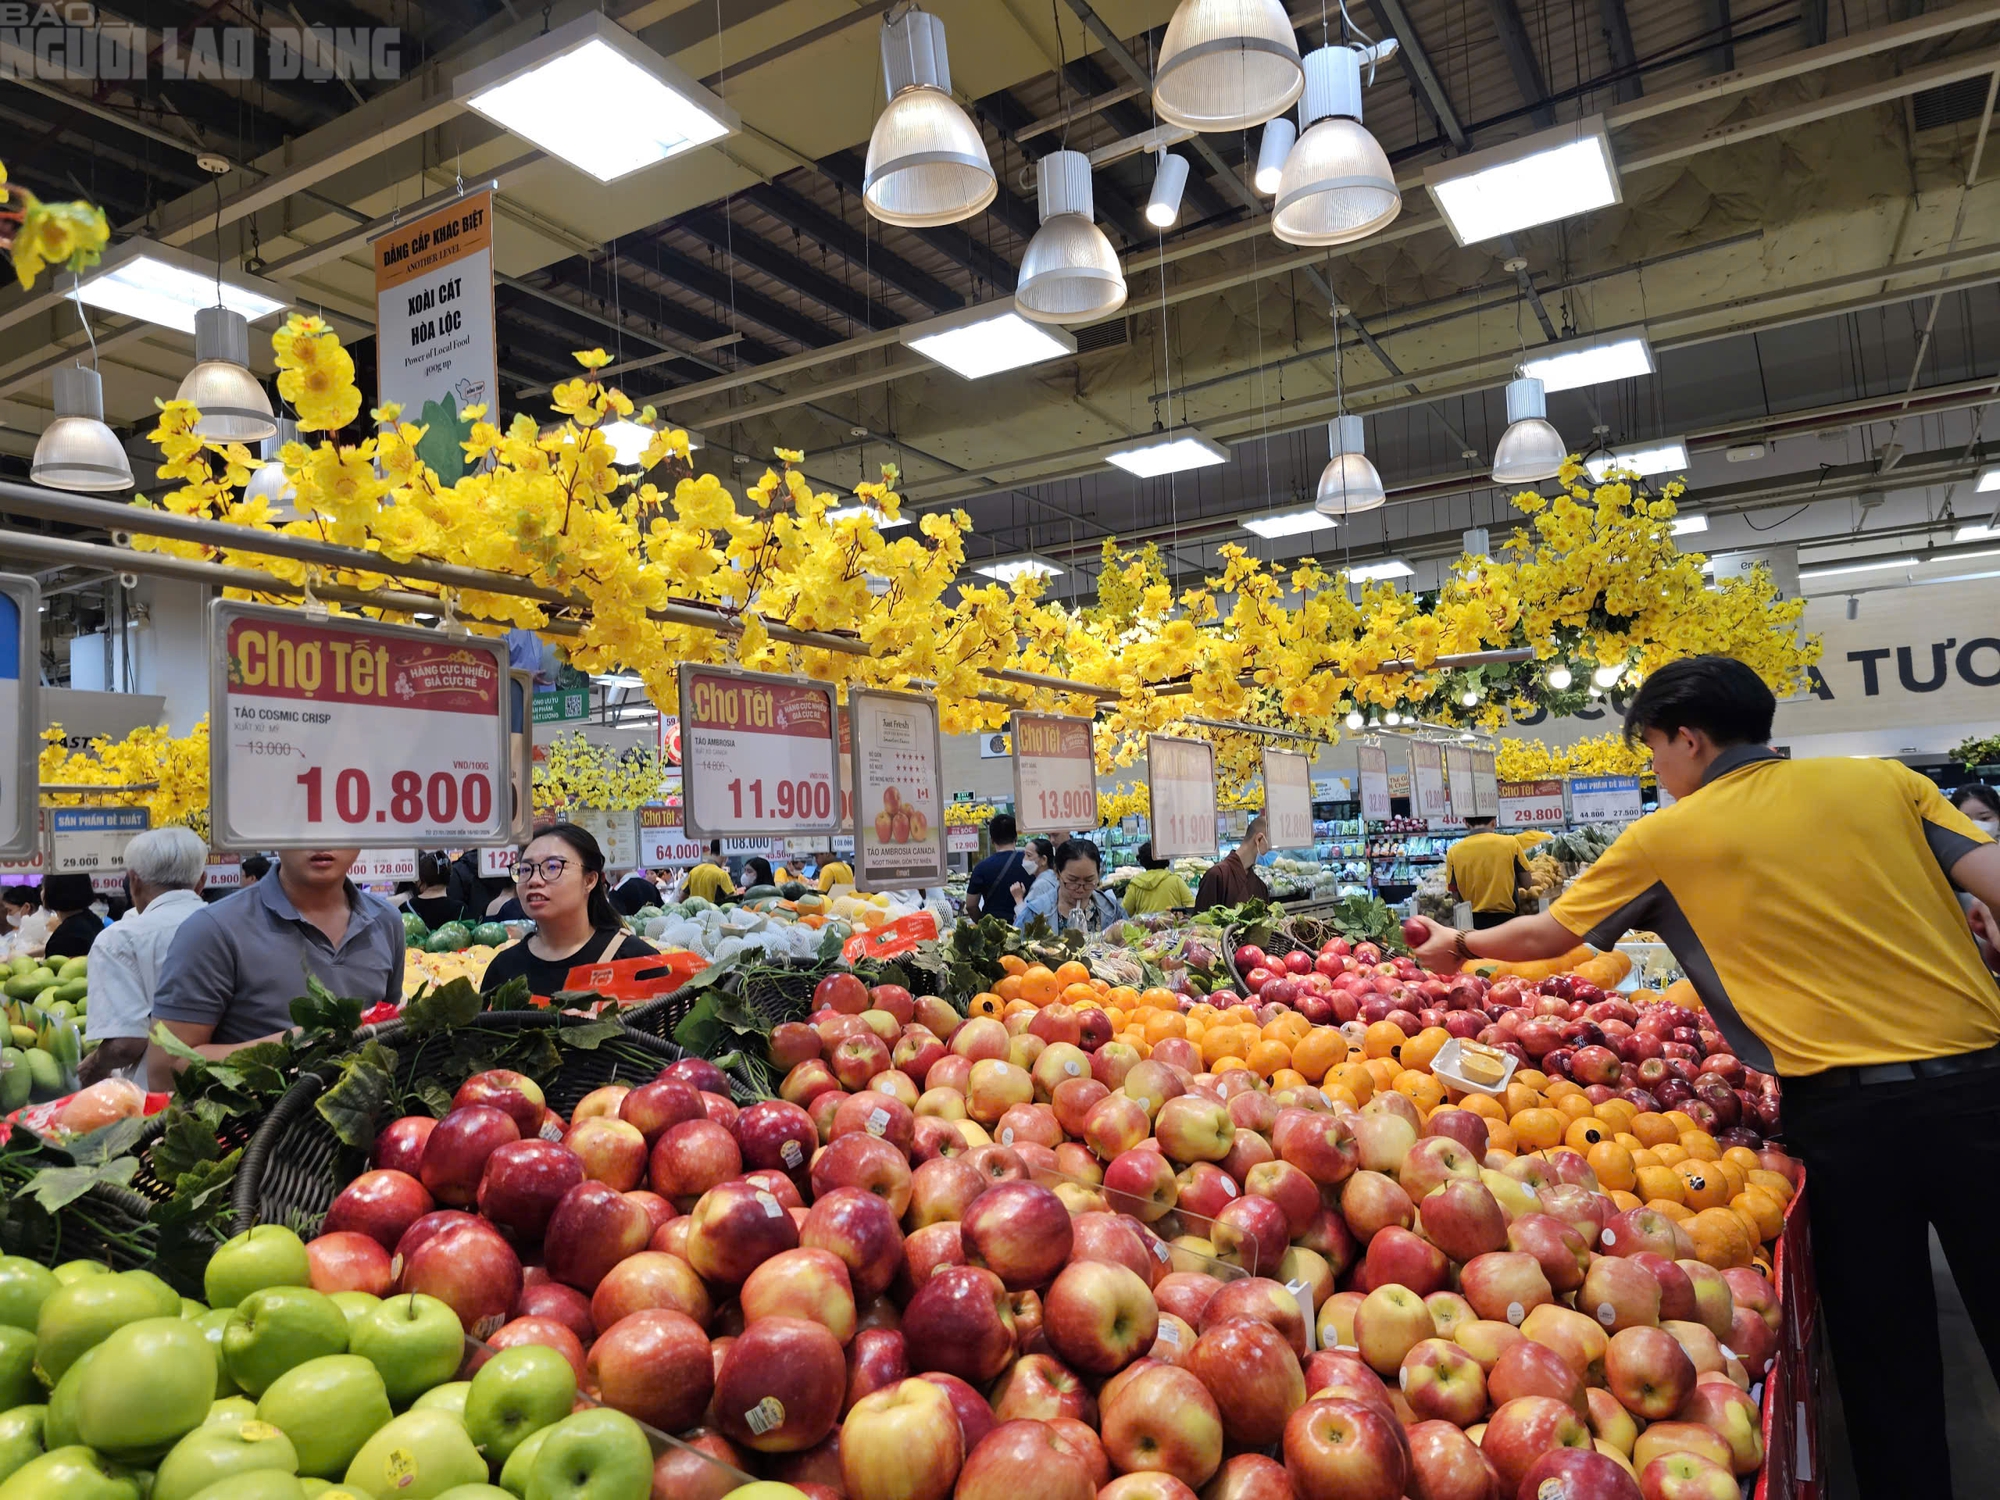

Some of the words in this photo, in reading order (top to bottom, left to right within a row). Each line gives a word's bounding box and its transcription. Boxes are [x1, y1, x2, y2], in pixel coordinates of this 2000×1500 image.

[433, 221, 460, 246] KHÁC
[462, 209, 484, 232] BIỆT
[406, 256, 438, 274] ANOTHER
[440, 244, 461, 260] LEVEL
[408, 288, 435, 317] XOÀI
[438, 278, 462, 304] CÁT
[411, 320, 436, 346] HÒA
[439, 310, 461, 338] LỘC
[404, 354, 425, 367] Power
[425, 351, 433, 359] of
[434, 341, 452, 357] Local
[453, 335, 470, 349] Food
[238, 630, 322, 697] Chợ
[330, 640, 389, 697] Tết
[410, 665, 438, 678] HÀNG
[440, 664, 461, 676] CỰC
[425, 675, 441, 687] GIÁ
[443, 676, 463, 688] CỰC
[695, 682, 738, 729] Chợ
[742, 686, 774, 727] Tết
[234, 706, 255, 719] TÁO
[259, 709, 299, 722] COSMIC
[302, 712, 331, 724] CRISP
[894, 720, 910, 729] Fresh
[248, 741, 291, 756] 13.000
[695, 737, 706, 746] TÁO
[707, 738, 735, 748] AMBROSIA
[1020, 724, 1043, 756] Chợ
[1044, 723, 1060, 753] Tết
[453, 760, 489, 771] VND/100G
[297, 767, 492, 824] 10.800
[728, 778, 830, 819] 11.900
[1039, 790, 1092, 819] 13.900
[643, 810, 660, 827] Chợ
[1515, 808, 1562, 821] 29.800
[1170, 814, 1213, 844] 11.900
[1280, 813, 1310, 838] 12.800
[656, 844, 699, 860] 64.000
[867, 847, 880, 856] TÁO
[881, 847, 912, 856] AMBROSIA
[912, 847, 935, 855] CANADA
[63, 857, 98, 867] 29.000
[374, 863, 413, 874] 128.000
[211, 874, 239, 884] 8.900
